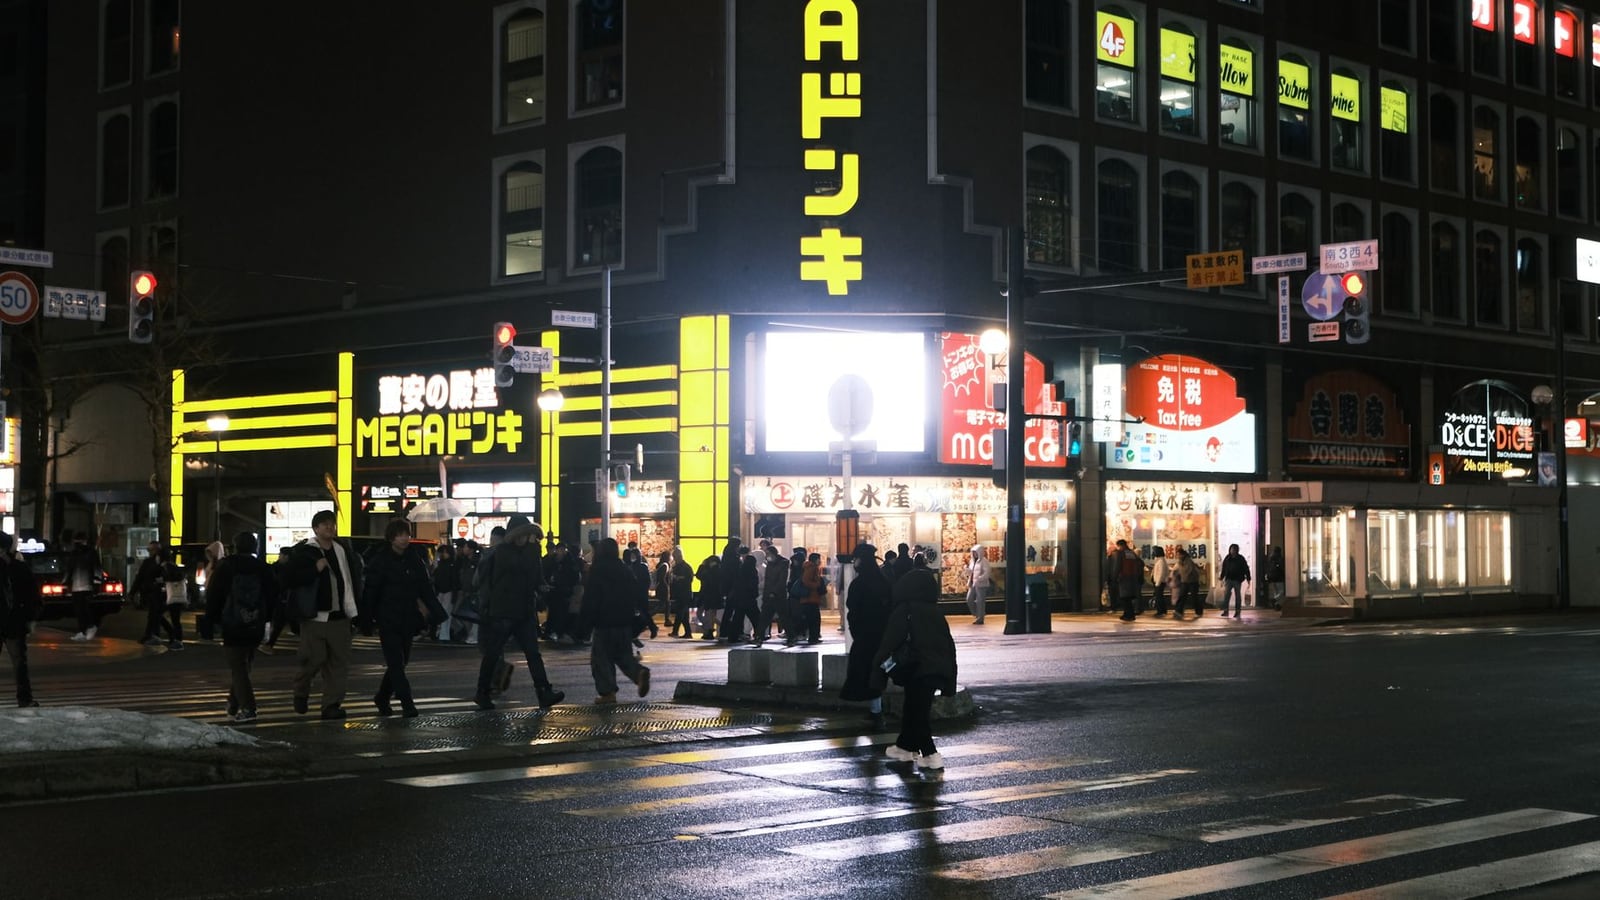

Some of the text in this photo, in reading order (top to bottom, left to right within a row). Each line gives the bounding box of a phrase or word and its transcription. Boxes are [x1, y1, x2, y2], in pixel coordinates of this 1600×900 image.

[1101, 21, 1126, 57] 4F
[1326, 245, 1373, 261] 南3西4
[1, 285, 28, 309] 50
[1157, 375, 1202, 405] 免税
[1157, 409, 1202, 427] Tax Free
[356, 409, 523, 458] MEGAドンキ
